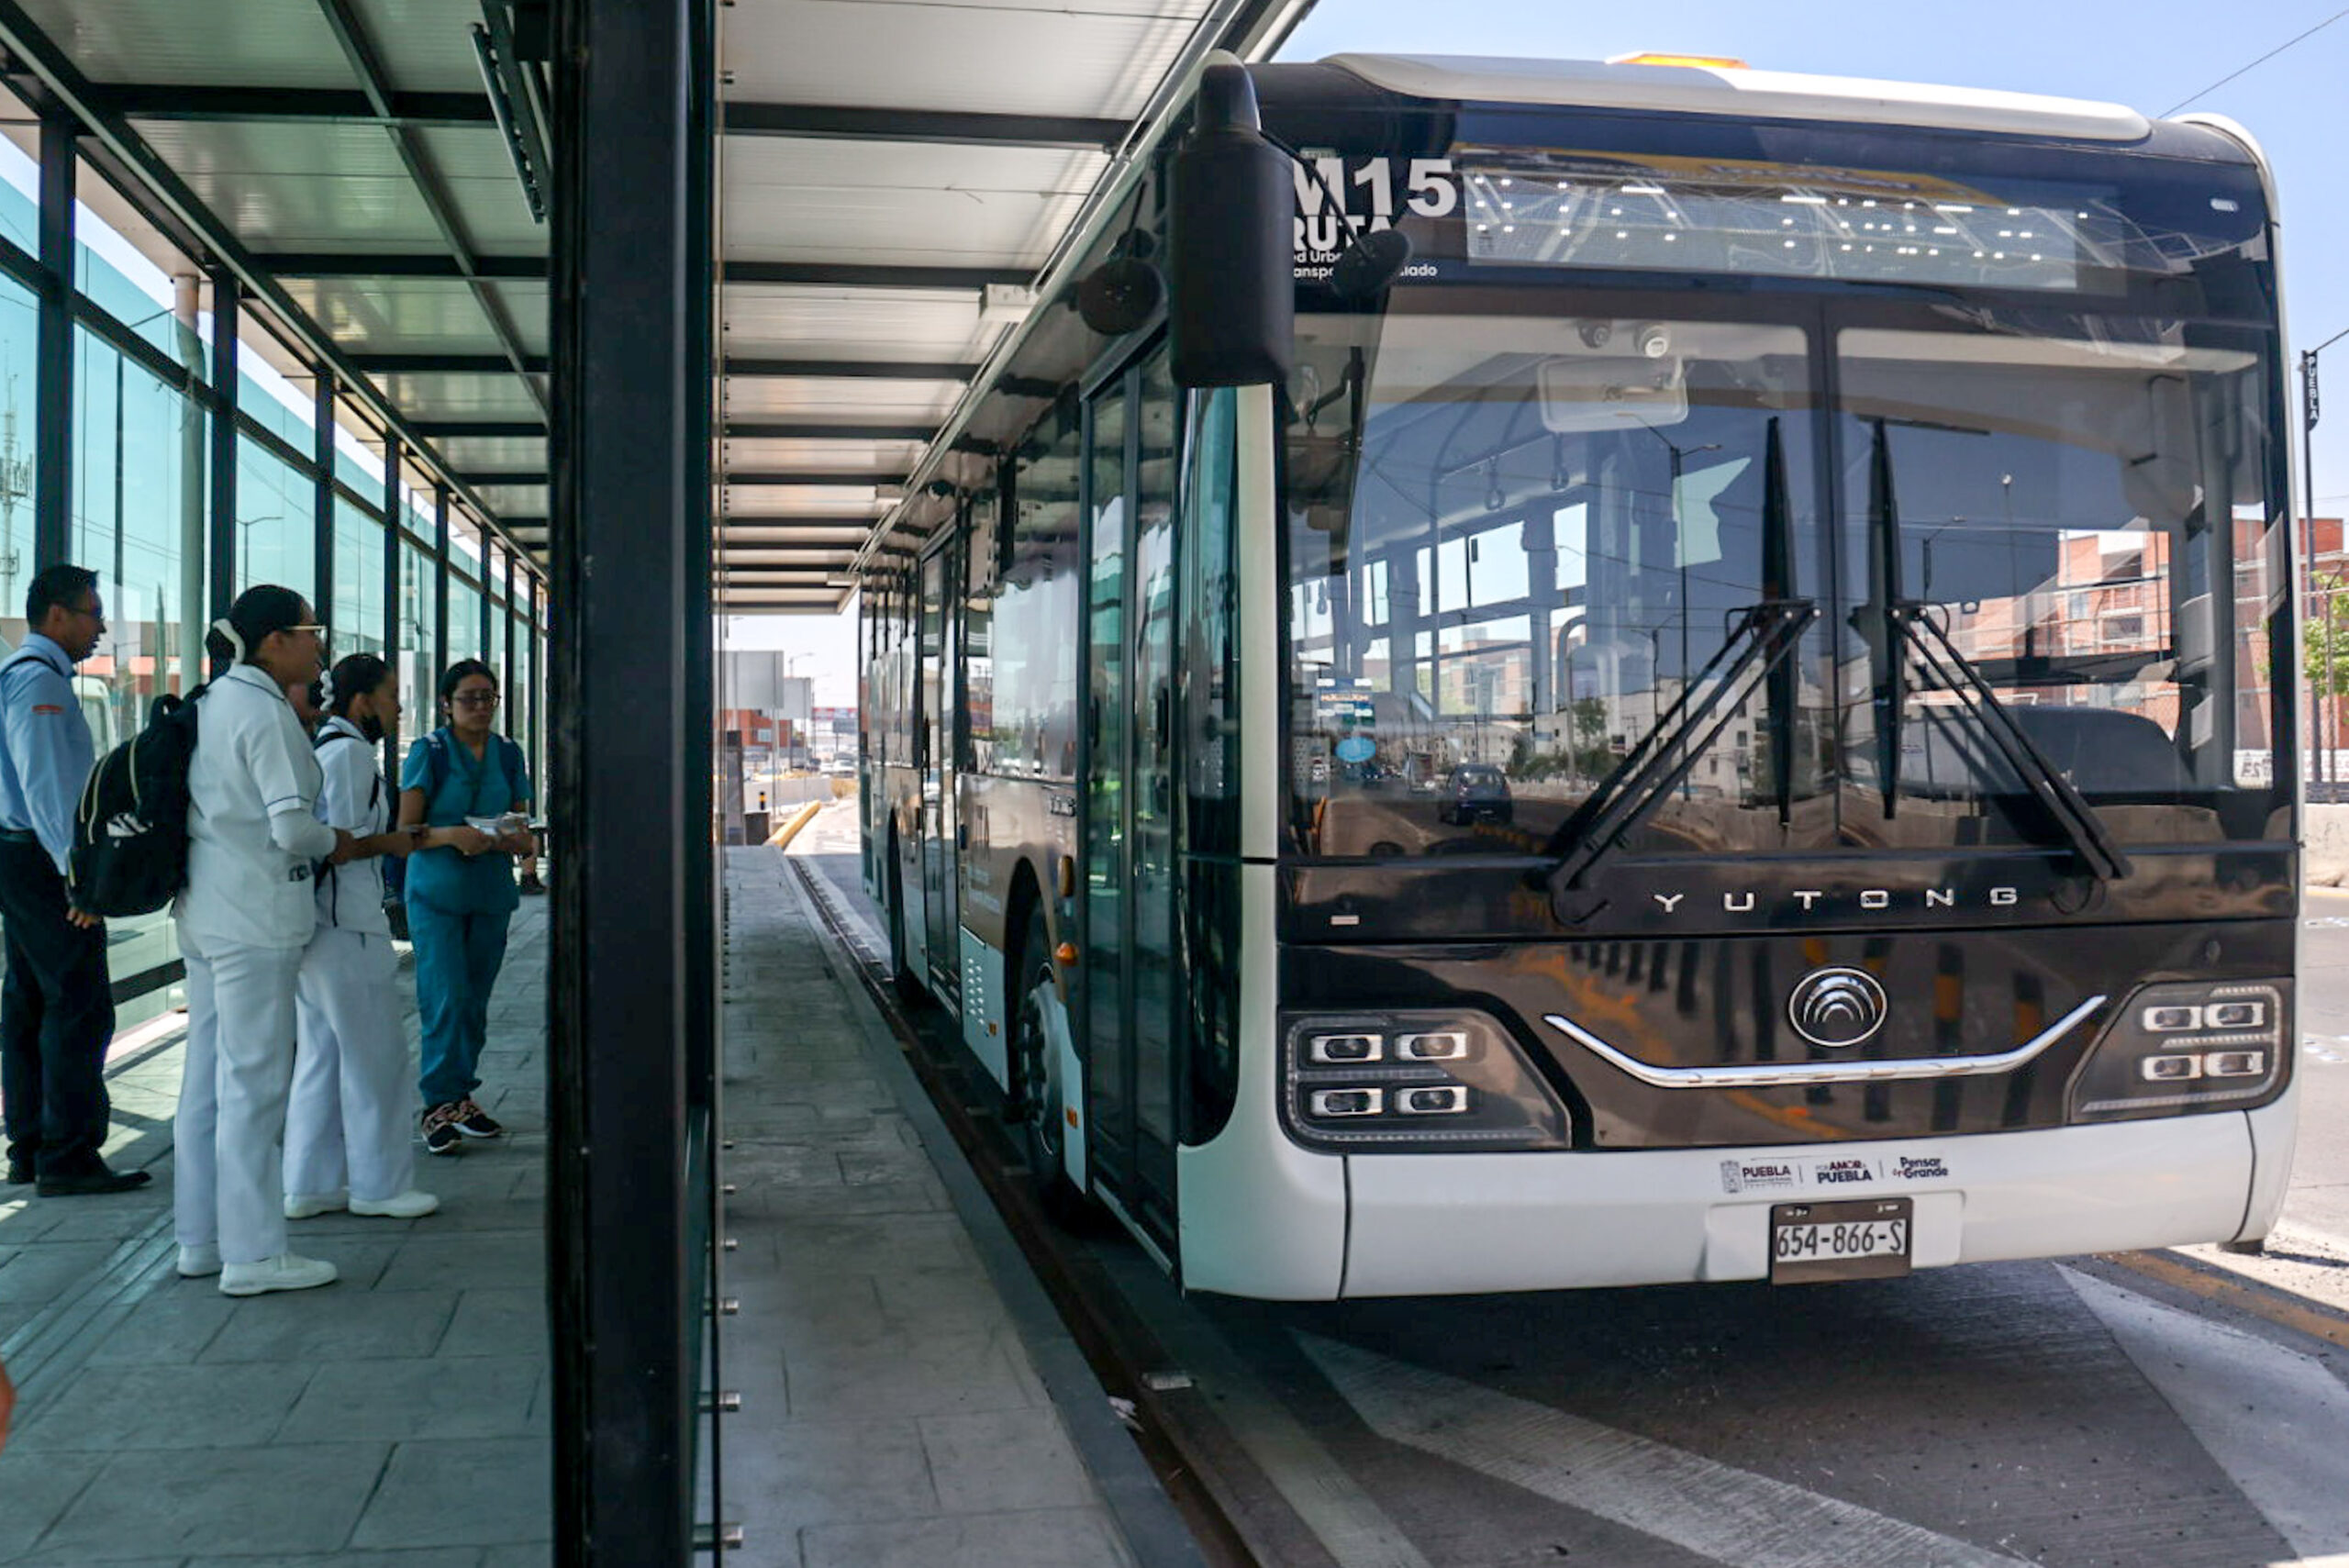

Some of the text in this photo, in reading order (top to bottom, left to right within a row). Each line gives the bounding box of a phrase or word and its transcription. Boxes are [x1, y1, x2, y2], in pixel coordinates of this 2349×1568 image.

[1293, 157, 1457, 217] M15
[1309, 249, 1342, 263] Urb
[1400, 262, 1438, 277] lado
[2308, 355, 2319, 419] PUEBLA
[1653, 886, 2018, 913] YUTONG
[1829, 1160, 1863, 1172] AMOR
[1899, 1155, 1943, 1169] Pensar
[1742, 1164, 1791, 1178] PUEBLA
[1817, 1169, 1874, 1184] PUEBLA
[1904, 1166, 1949, 1179] Grande
[1776, 1219, 1904, 1258] 654-866-S
